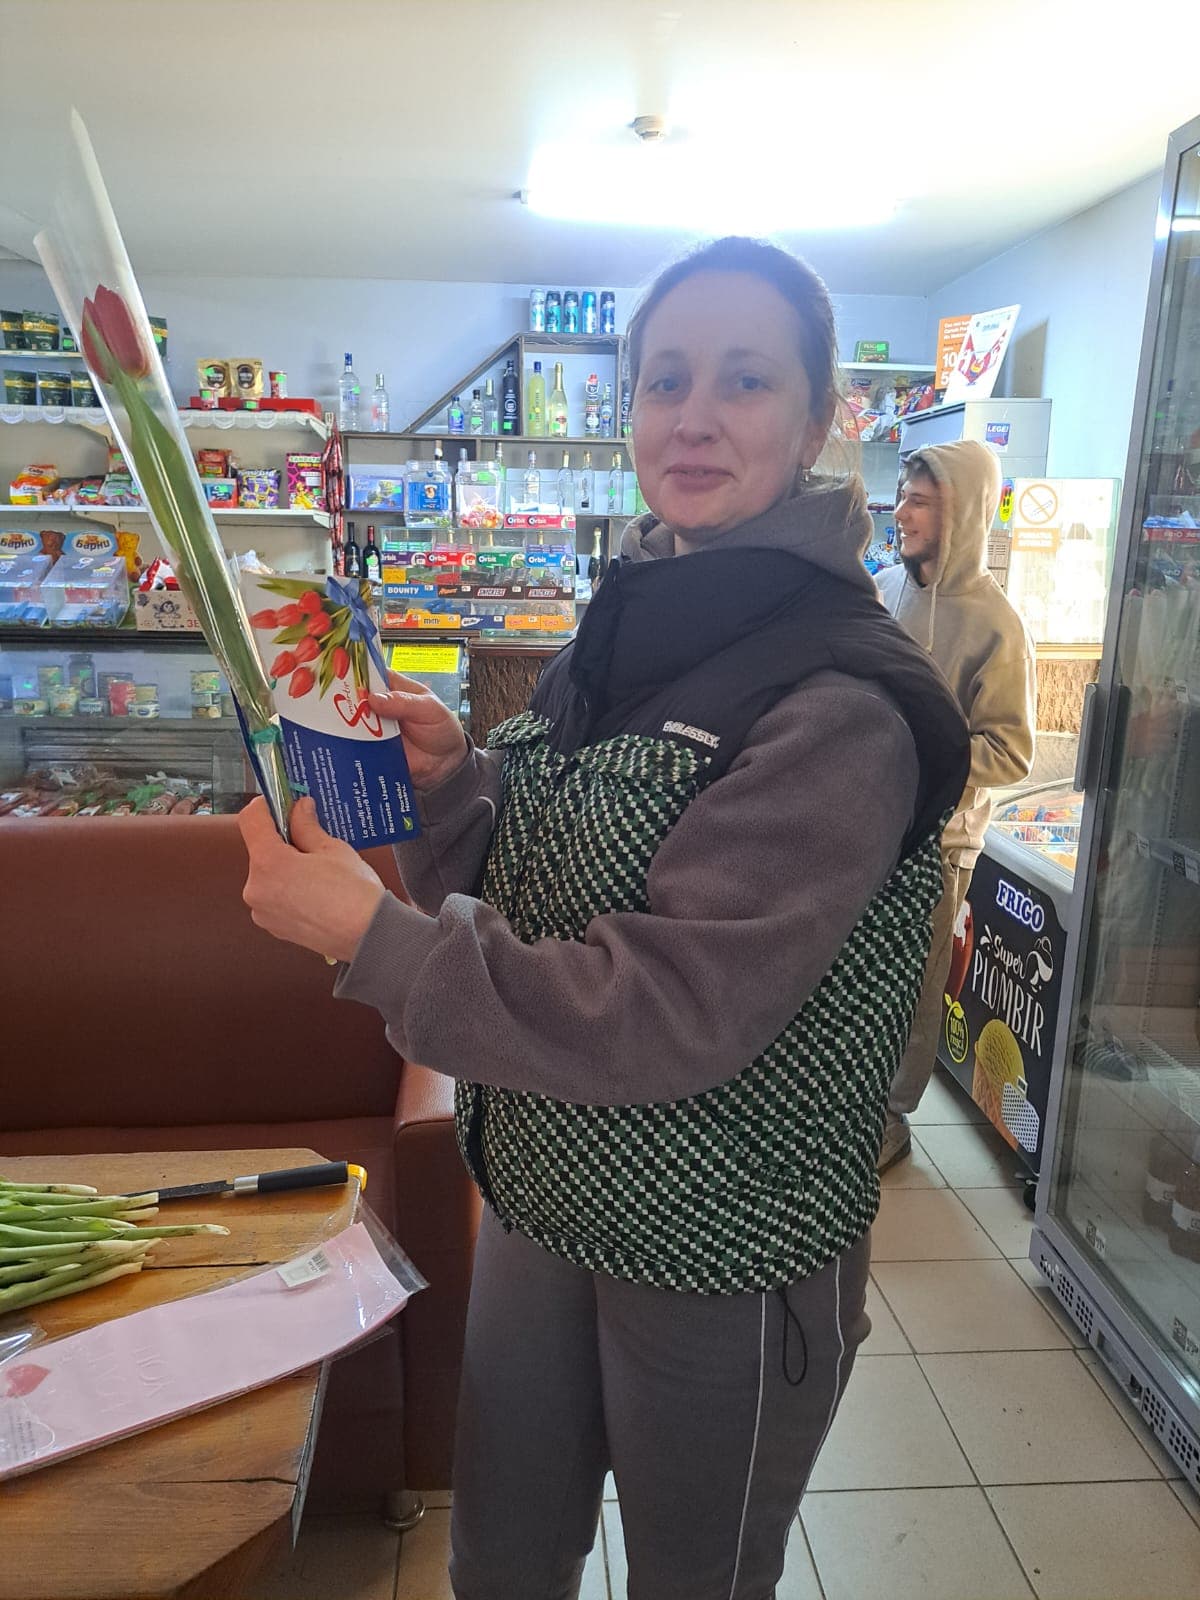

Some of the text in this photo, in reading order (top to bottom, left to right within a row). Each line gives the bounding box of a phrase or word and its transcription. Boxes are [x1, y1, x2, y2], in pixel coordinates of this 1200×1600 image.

[0, 537, 35, 550] Барни
[75, 538, 110, 551] Барни
[427, 553, 447, 562] Orbit
[478, 554, 497, 563] Orbit
[527, 554, 547, 563] Orbit
[387, 586, 419, 594] BOUNTY
[996, 880, 1045, 932] FRIGO
[994, 937, 1024, 980] Super
[971, 948, 1044, 1056] PLOMBIR
